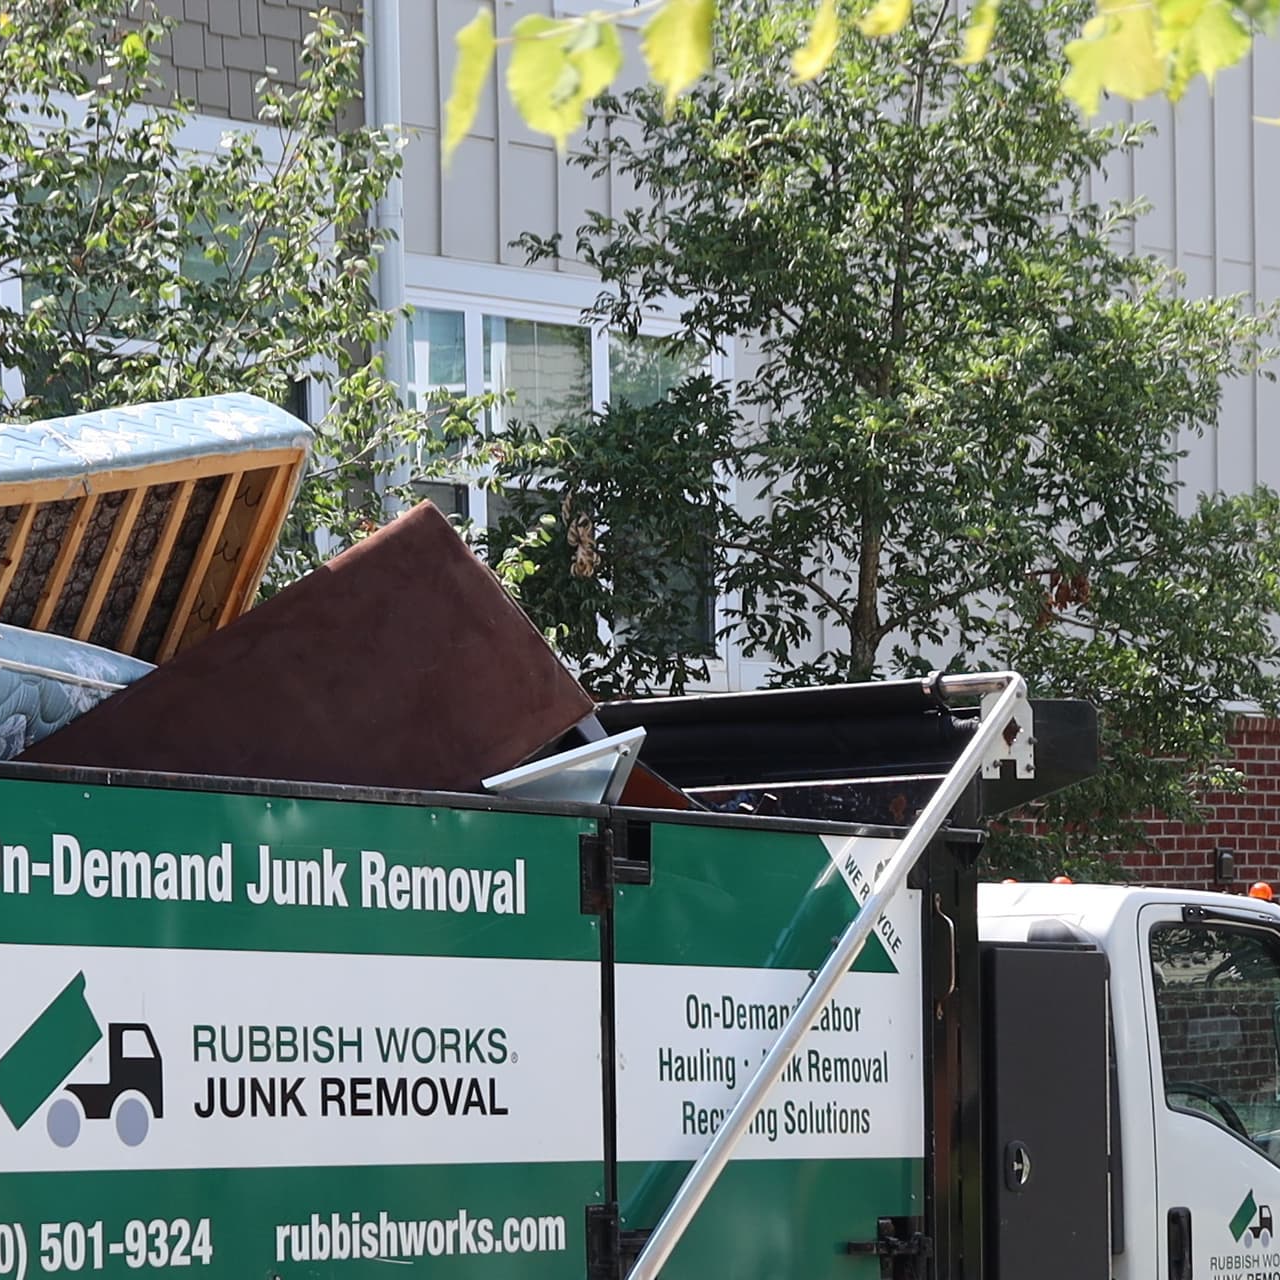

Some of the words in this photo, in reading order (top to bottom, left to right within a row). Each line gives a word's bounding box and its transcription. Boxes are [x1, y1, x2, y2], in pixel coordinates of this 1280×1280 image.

[247, 845, 348, 907] Junk
[361, 851, 525, 914] Removal
[844, 854, 863, 887] WE
[859, 881, 903, 955] RYCLE
[686, 994, 800, 1031] On-Deman
[811, 999, 860, 1032] abor
[194, 1025, 362, 1063] RUBBISH
[659, 1048, 735, 1090] Hauling
[808, 1050, 888, 1083] Removal
[195, 1078, 307, 1118] JUNK
[321, 1077, 508, 1116] REMOVAL
[683, 1101, 777, 1141] Recng
[784, 1101, 870, 1134] Solutions
[41, 1219, 212, 1271] 501-9324
[277, 1210, 565, 1258] rubbishworks.com
[1210, 1255, 1259, 1270] RUBBISH
